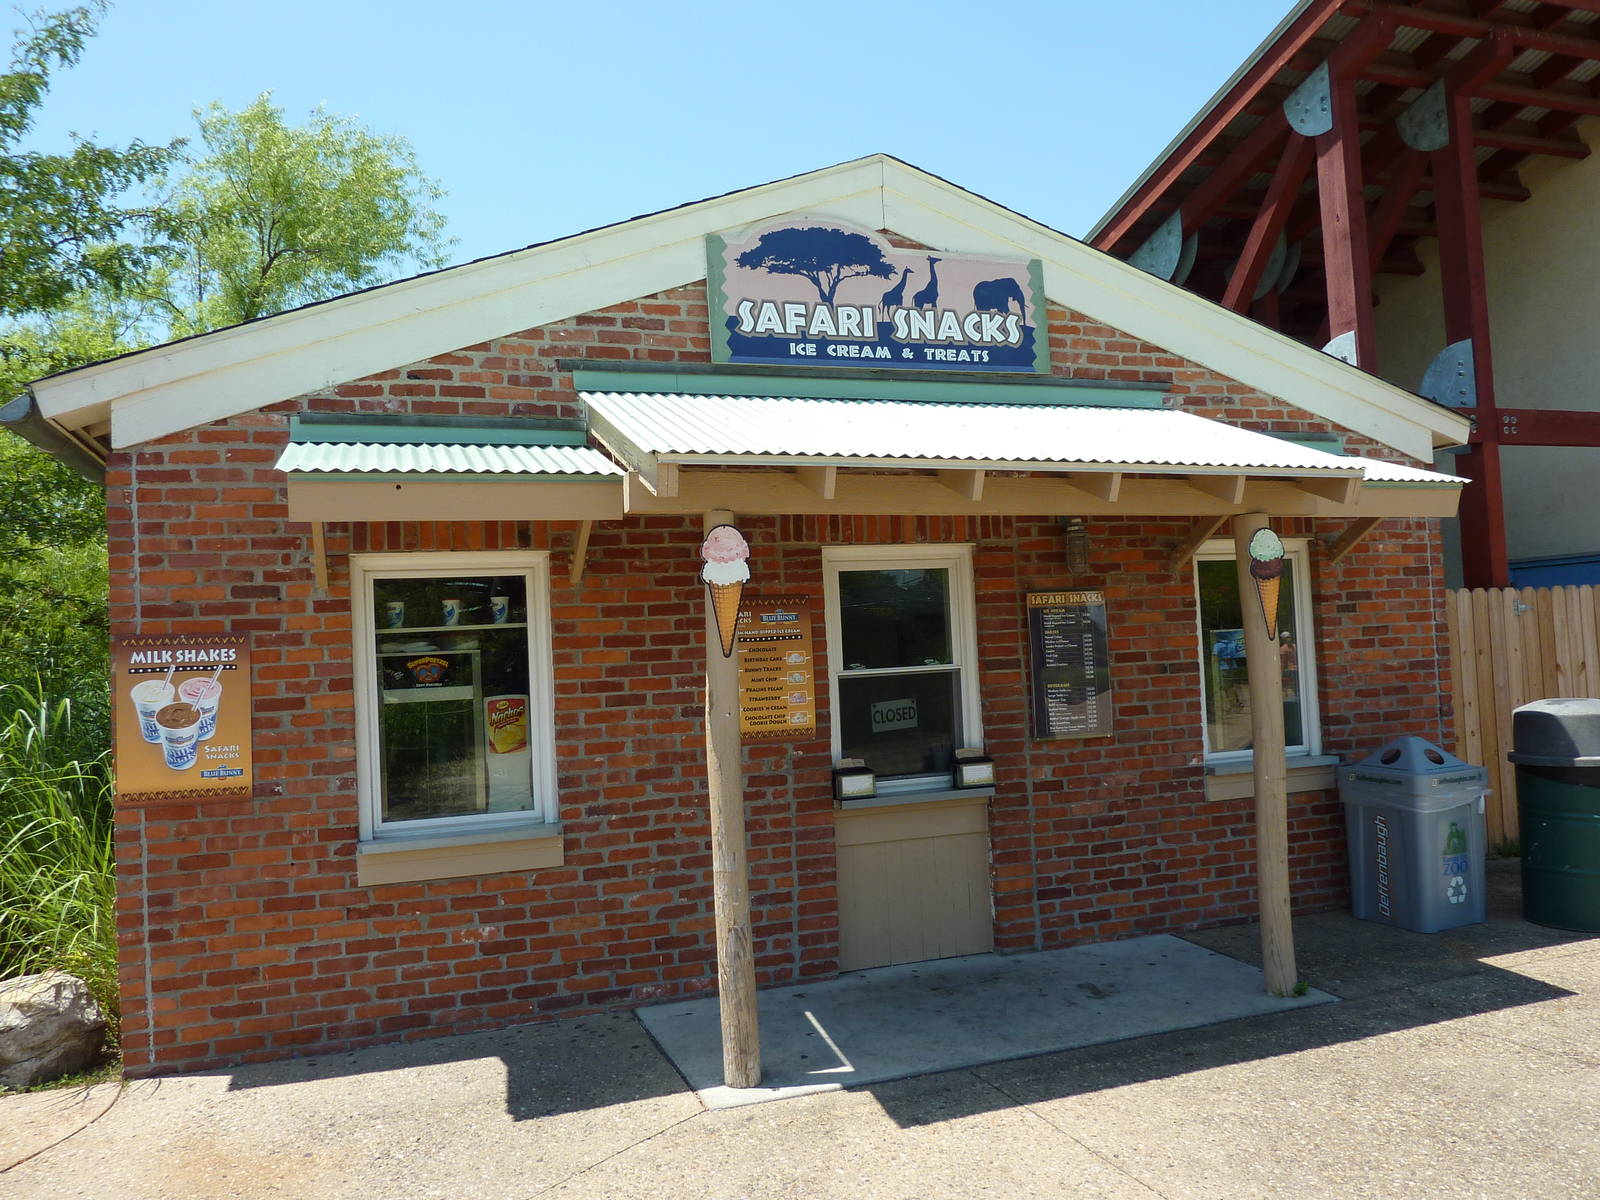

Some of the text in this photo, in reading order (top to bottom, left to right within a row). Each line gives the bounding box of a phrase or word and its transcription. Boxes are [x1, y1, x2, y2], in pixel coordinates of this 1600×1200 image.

[738, 300, 1021, 344] SAFARI SNACKS
[789, 343, 989, 362] ICE CREAM & TREATS
[1031, 593, 1102, 605] SAFARI SNACKS
[130, 648, 237, 664] MILK SHAKES
[873, 706, 916, 724] CLOSED
[204, 744, 240, 752] SAFARI
[1443, 861, 1468, 875] ZOO
